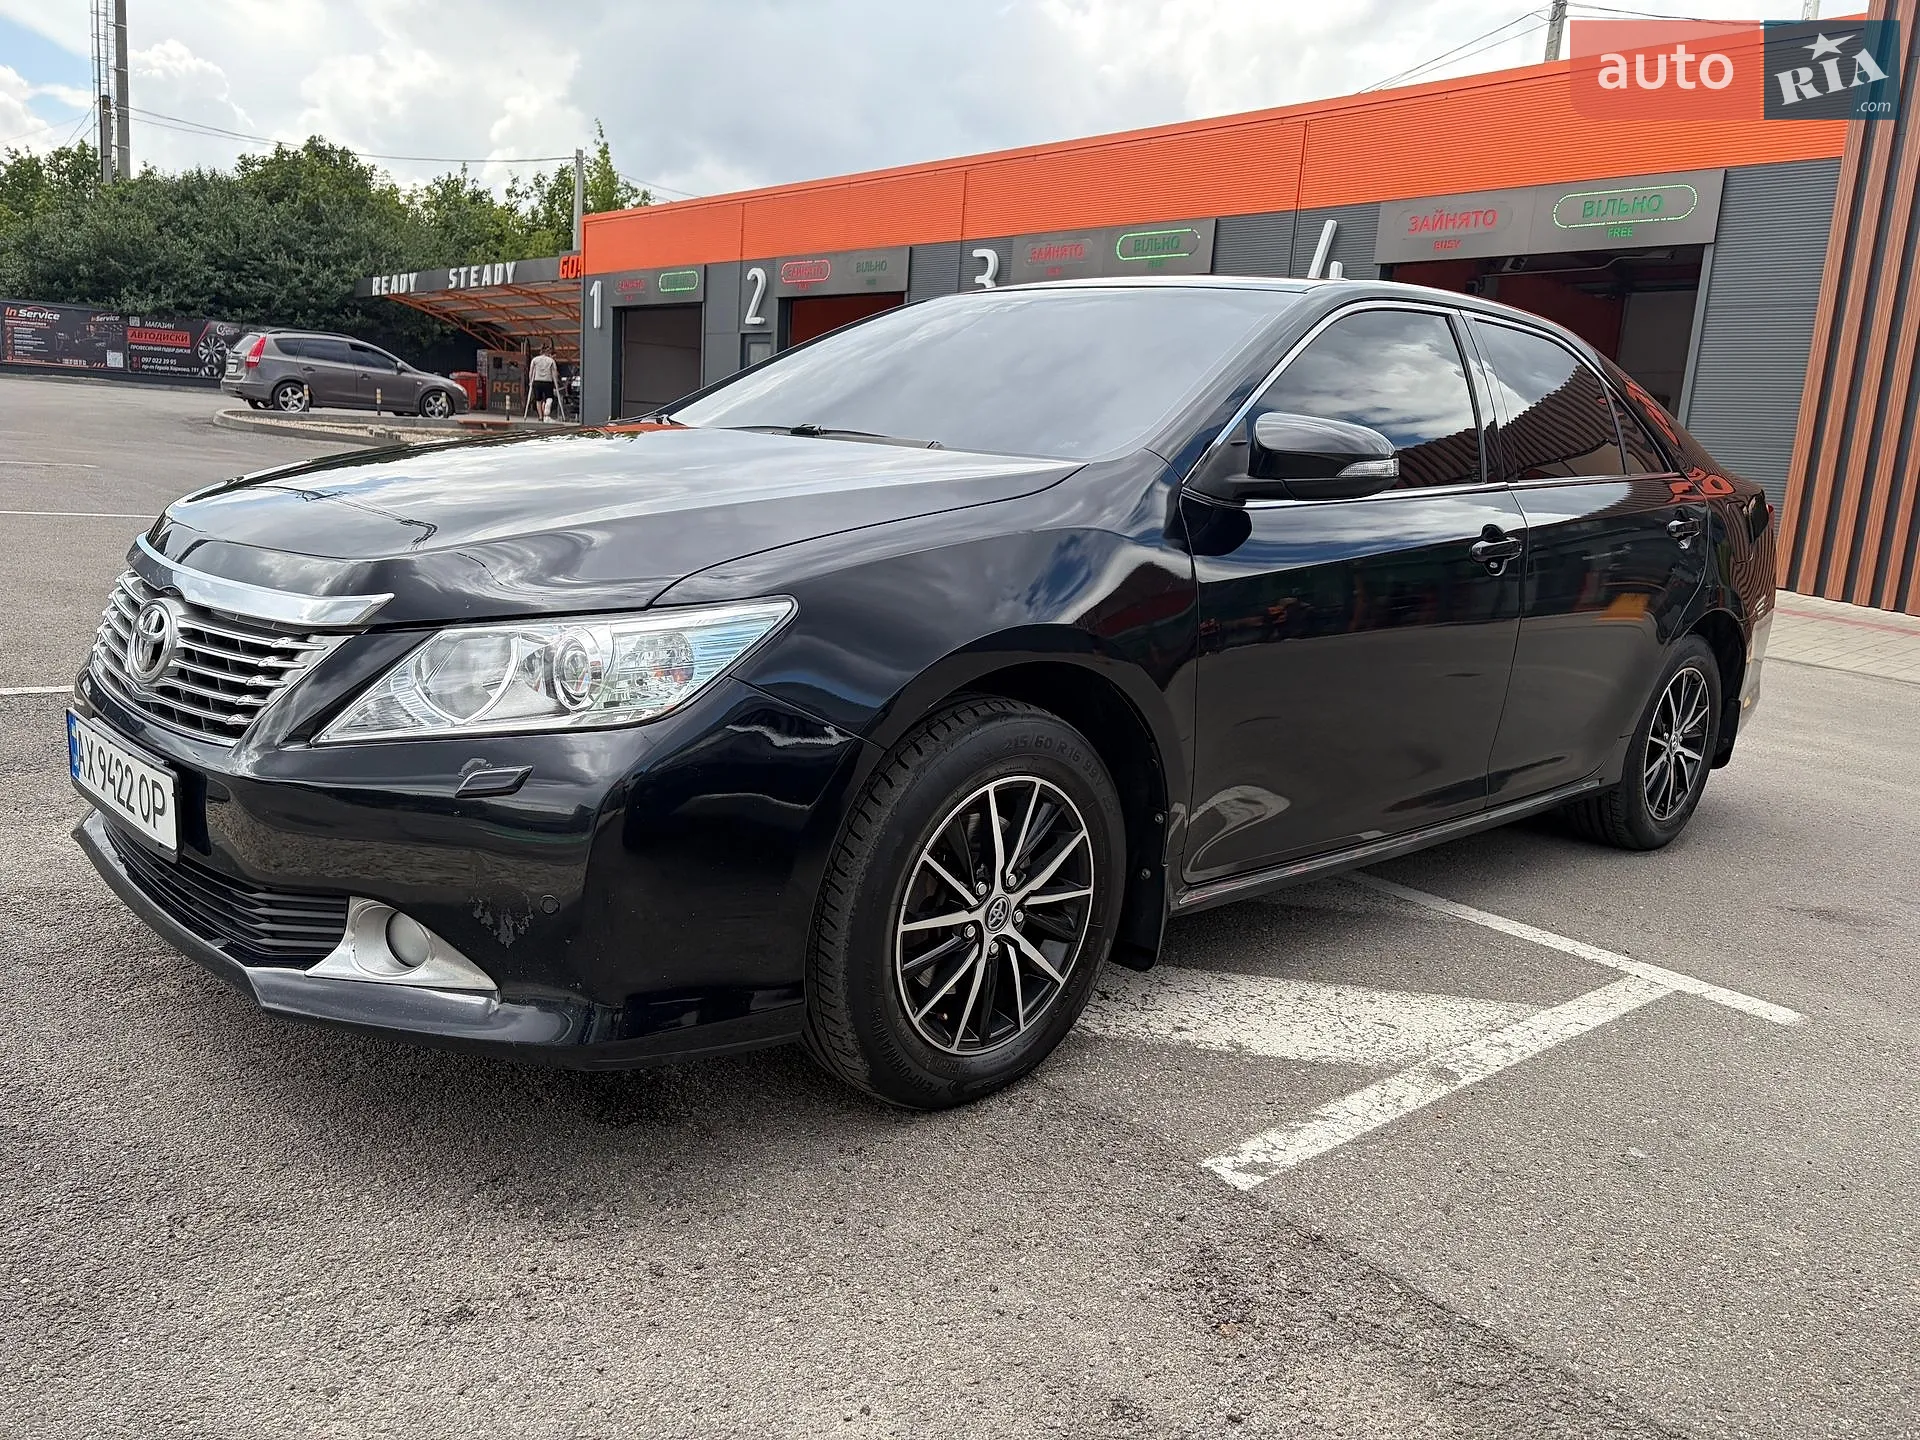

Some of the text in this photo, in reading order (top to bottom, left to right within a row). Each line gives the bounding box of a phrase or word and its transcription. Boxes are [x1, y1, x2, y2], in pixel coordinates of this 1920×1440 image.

[1582, 195, 1664, 218] ВІЛЬНО
[1408, 209, 1498, 232] ЗАЙНЯТО
[1607, 227, 1634, 239] FREE
[1030, 244, 1085, 262] ЗАЙНЯТО
[1132, 236, 1180, 253] ВІЛЬНО
[855, 260, 887, 273] ВІЛЬНО
[371, 272, 418, 296] READY
[447, 261, 516, 289] STEADY
[589, 280, 602, 329] 1
[744, 267, 768, 325] 2
[5, 307, 17, 316] In
[18, 309, 61, 321] Service
[144, 321, 175, 330] МАГАЗИН
[130, 330, 188, 344] АВТОДИСКИ
[492, 382, 520, 393] RSG
[78, 730, 166, 830] AX 9422 OP
